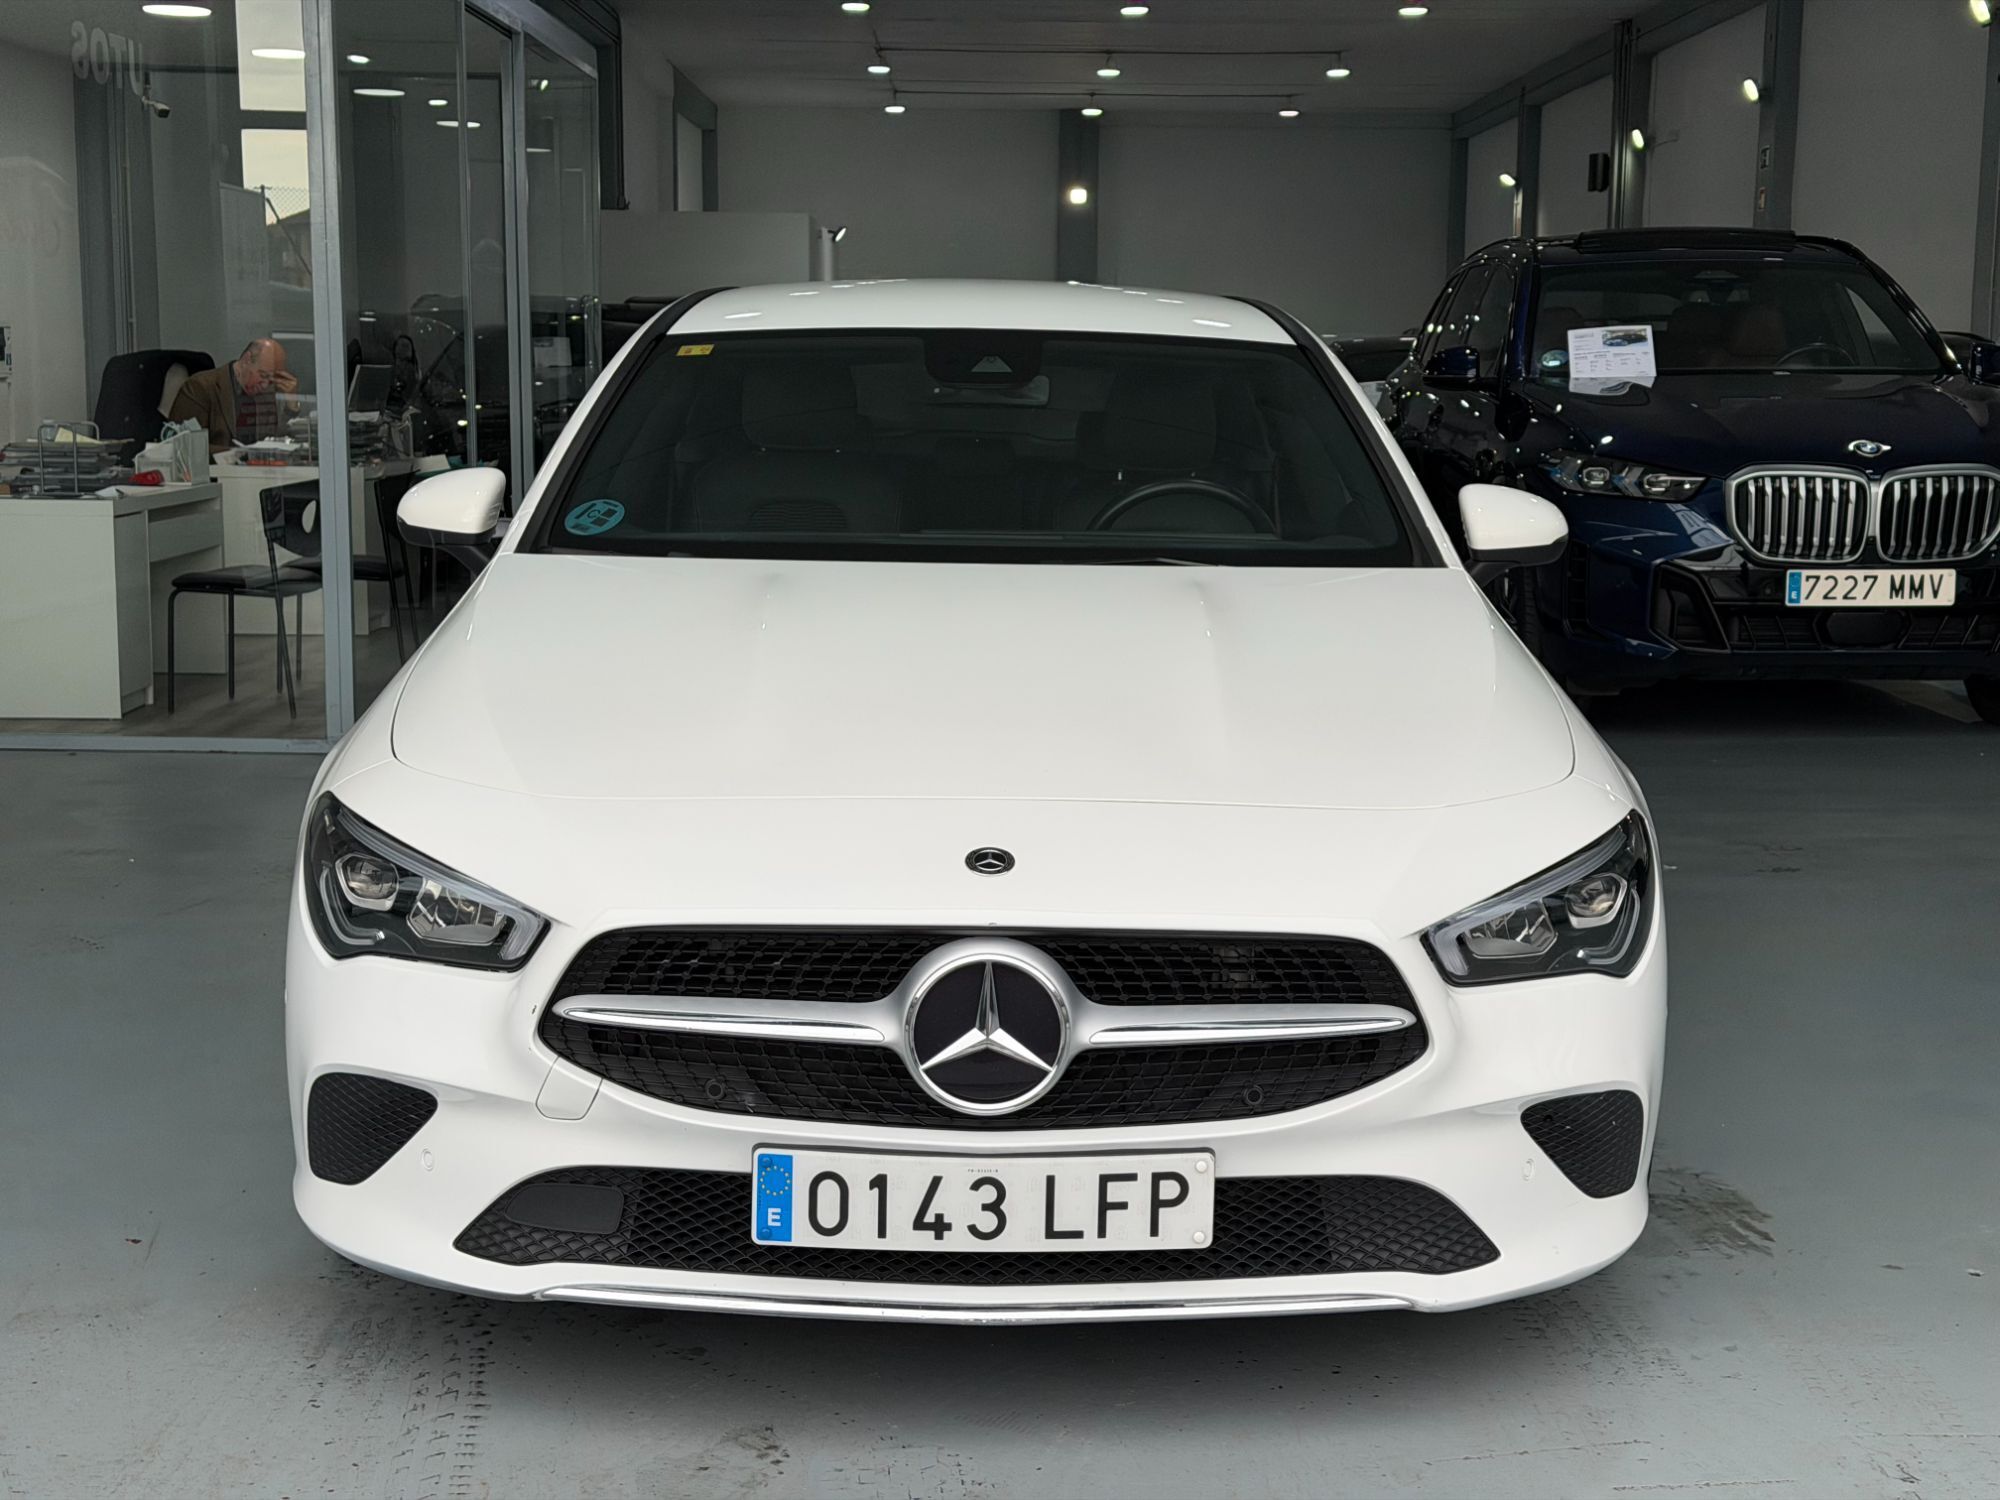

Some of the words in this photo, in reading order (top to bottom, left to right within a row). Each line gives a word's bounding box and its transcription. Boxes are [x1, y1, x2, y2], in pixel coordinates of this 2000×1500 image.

[1804, 575, 1879, 600] 7227
[1889, 574, 1944, 600] MMV
[767, 1207, 782, 1227] E
[807, 1170, 1008, 1241] 0143
[1044, 1170, 1190, 1240] LFP
